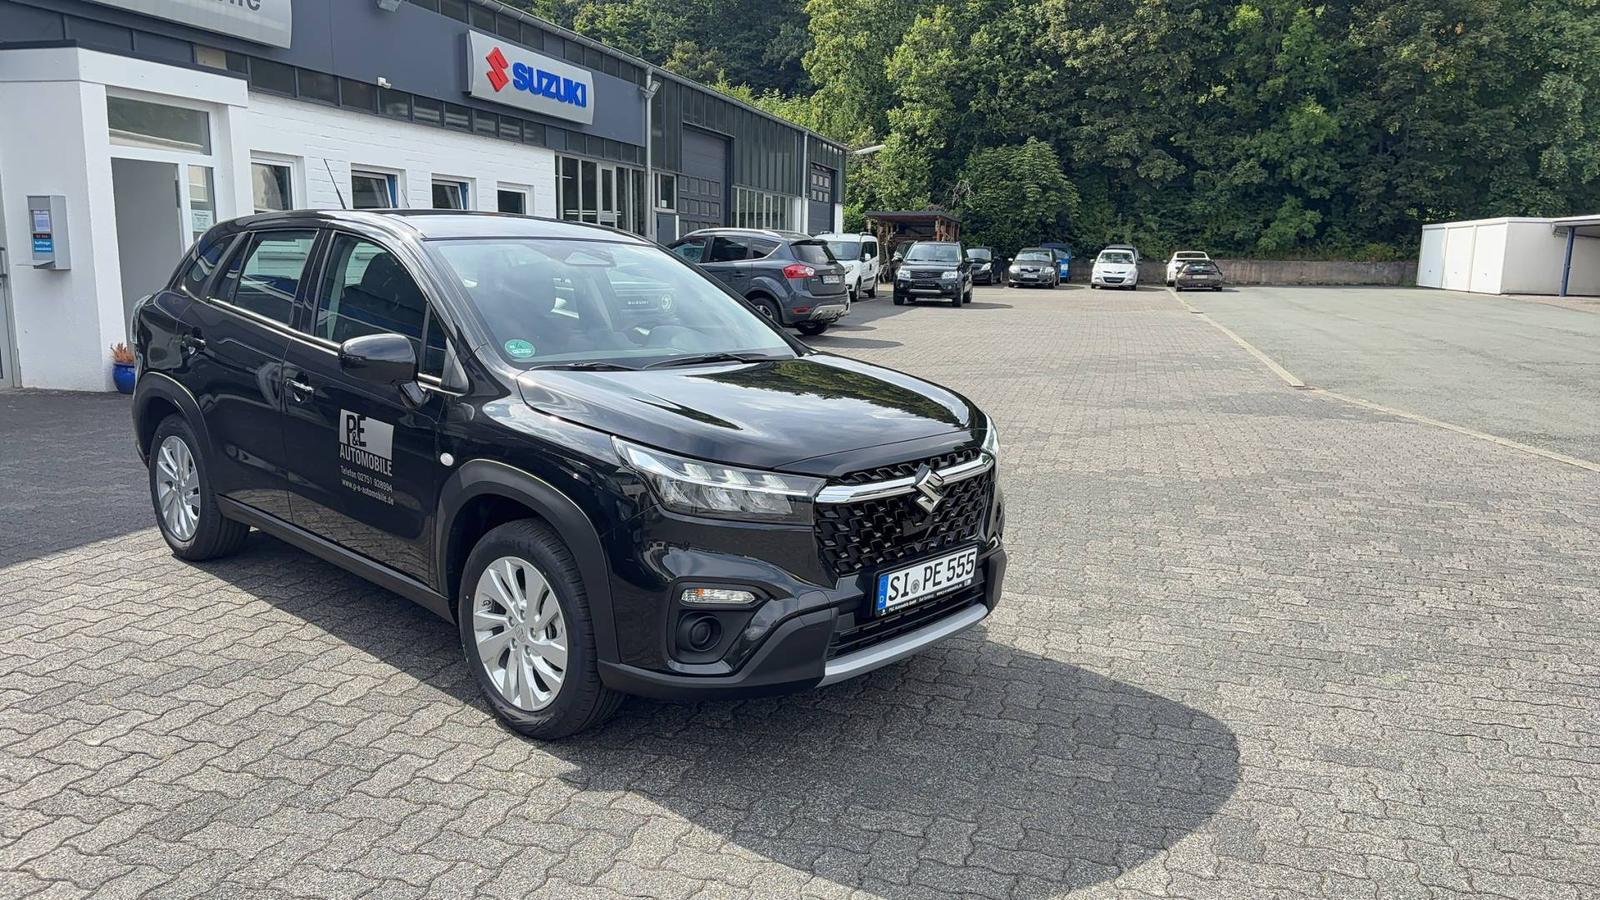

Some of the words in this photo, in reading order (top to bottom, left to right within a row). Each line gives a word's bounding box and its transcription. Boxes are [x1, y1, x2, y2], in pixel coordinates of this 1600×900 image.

[512, 62, 587, 108] SUZUKI
[340, 444, 392, 476] AUTOMOBILE
[888, 572, 909, 601] SI
[923, 562, 943, 591] PE
[946, 551, 975, 582] 555
